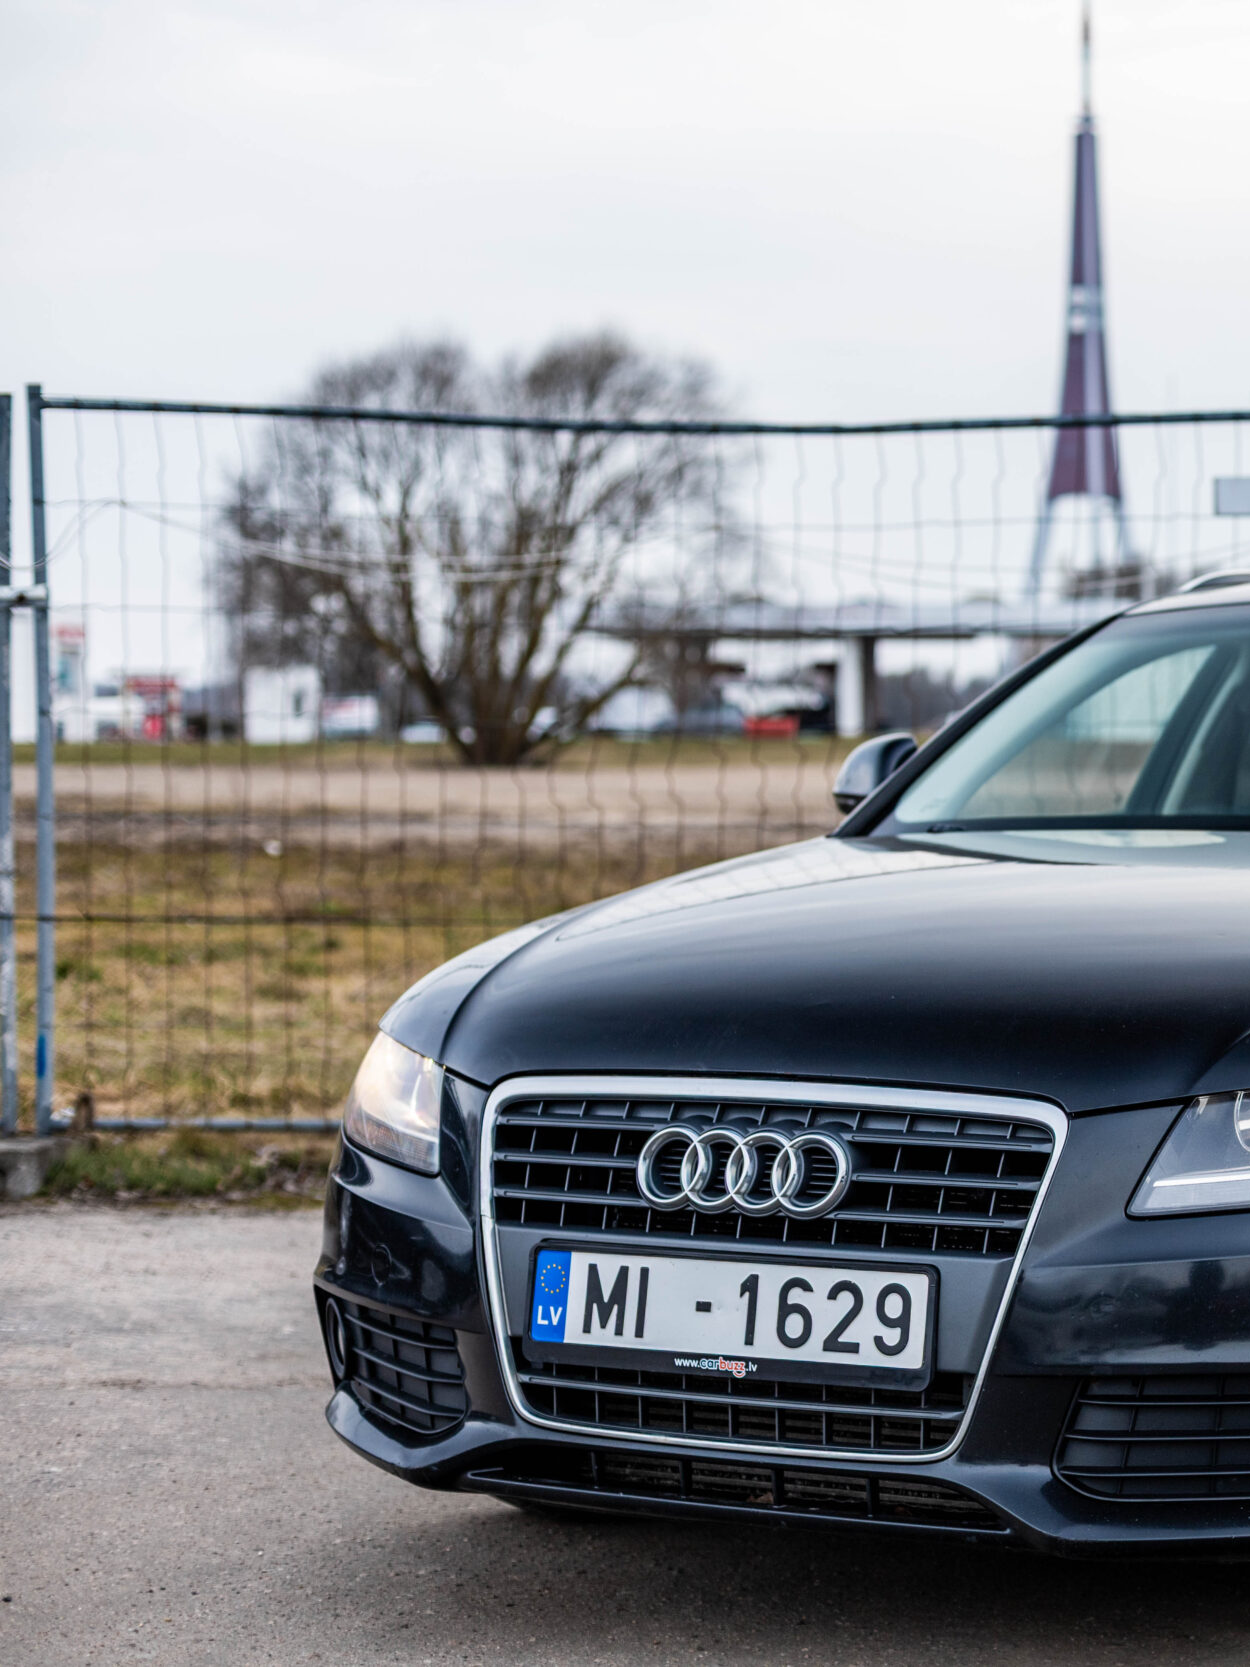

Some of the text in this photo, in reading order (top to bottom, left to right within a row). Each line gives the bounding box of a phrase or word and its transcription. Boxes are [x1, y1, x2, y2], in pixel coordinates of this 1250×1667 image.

[582, 1263, 650, 1338] MI
[537, 1305, 564, 1326] LV
[674, 1356, 758, 1373] www.carbuzz.lv
